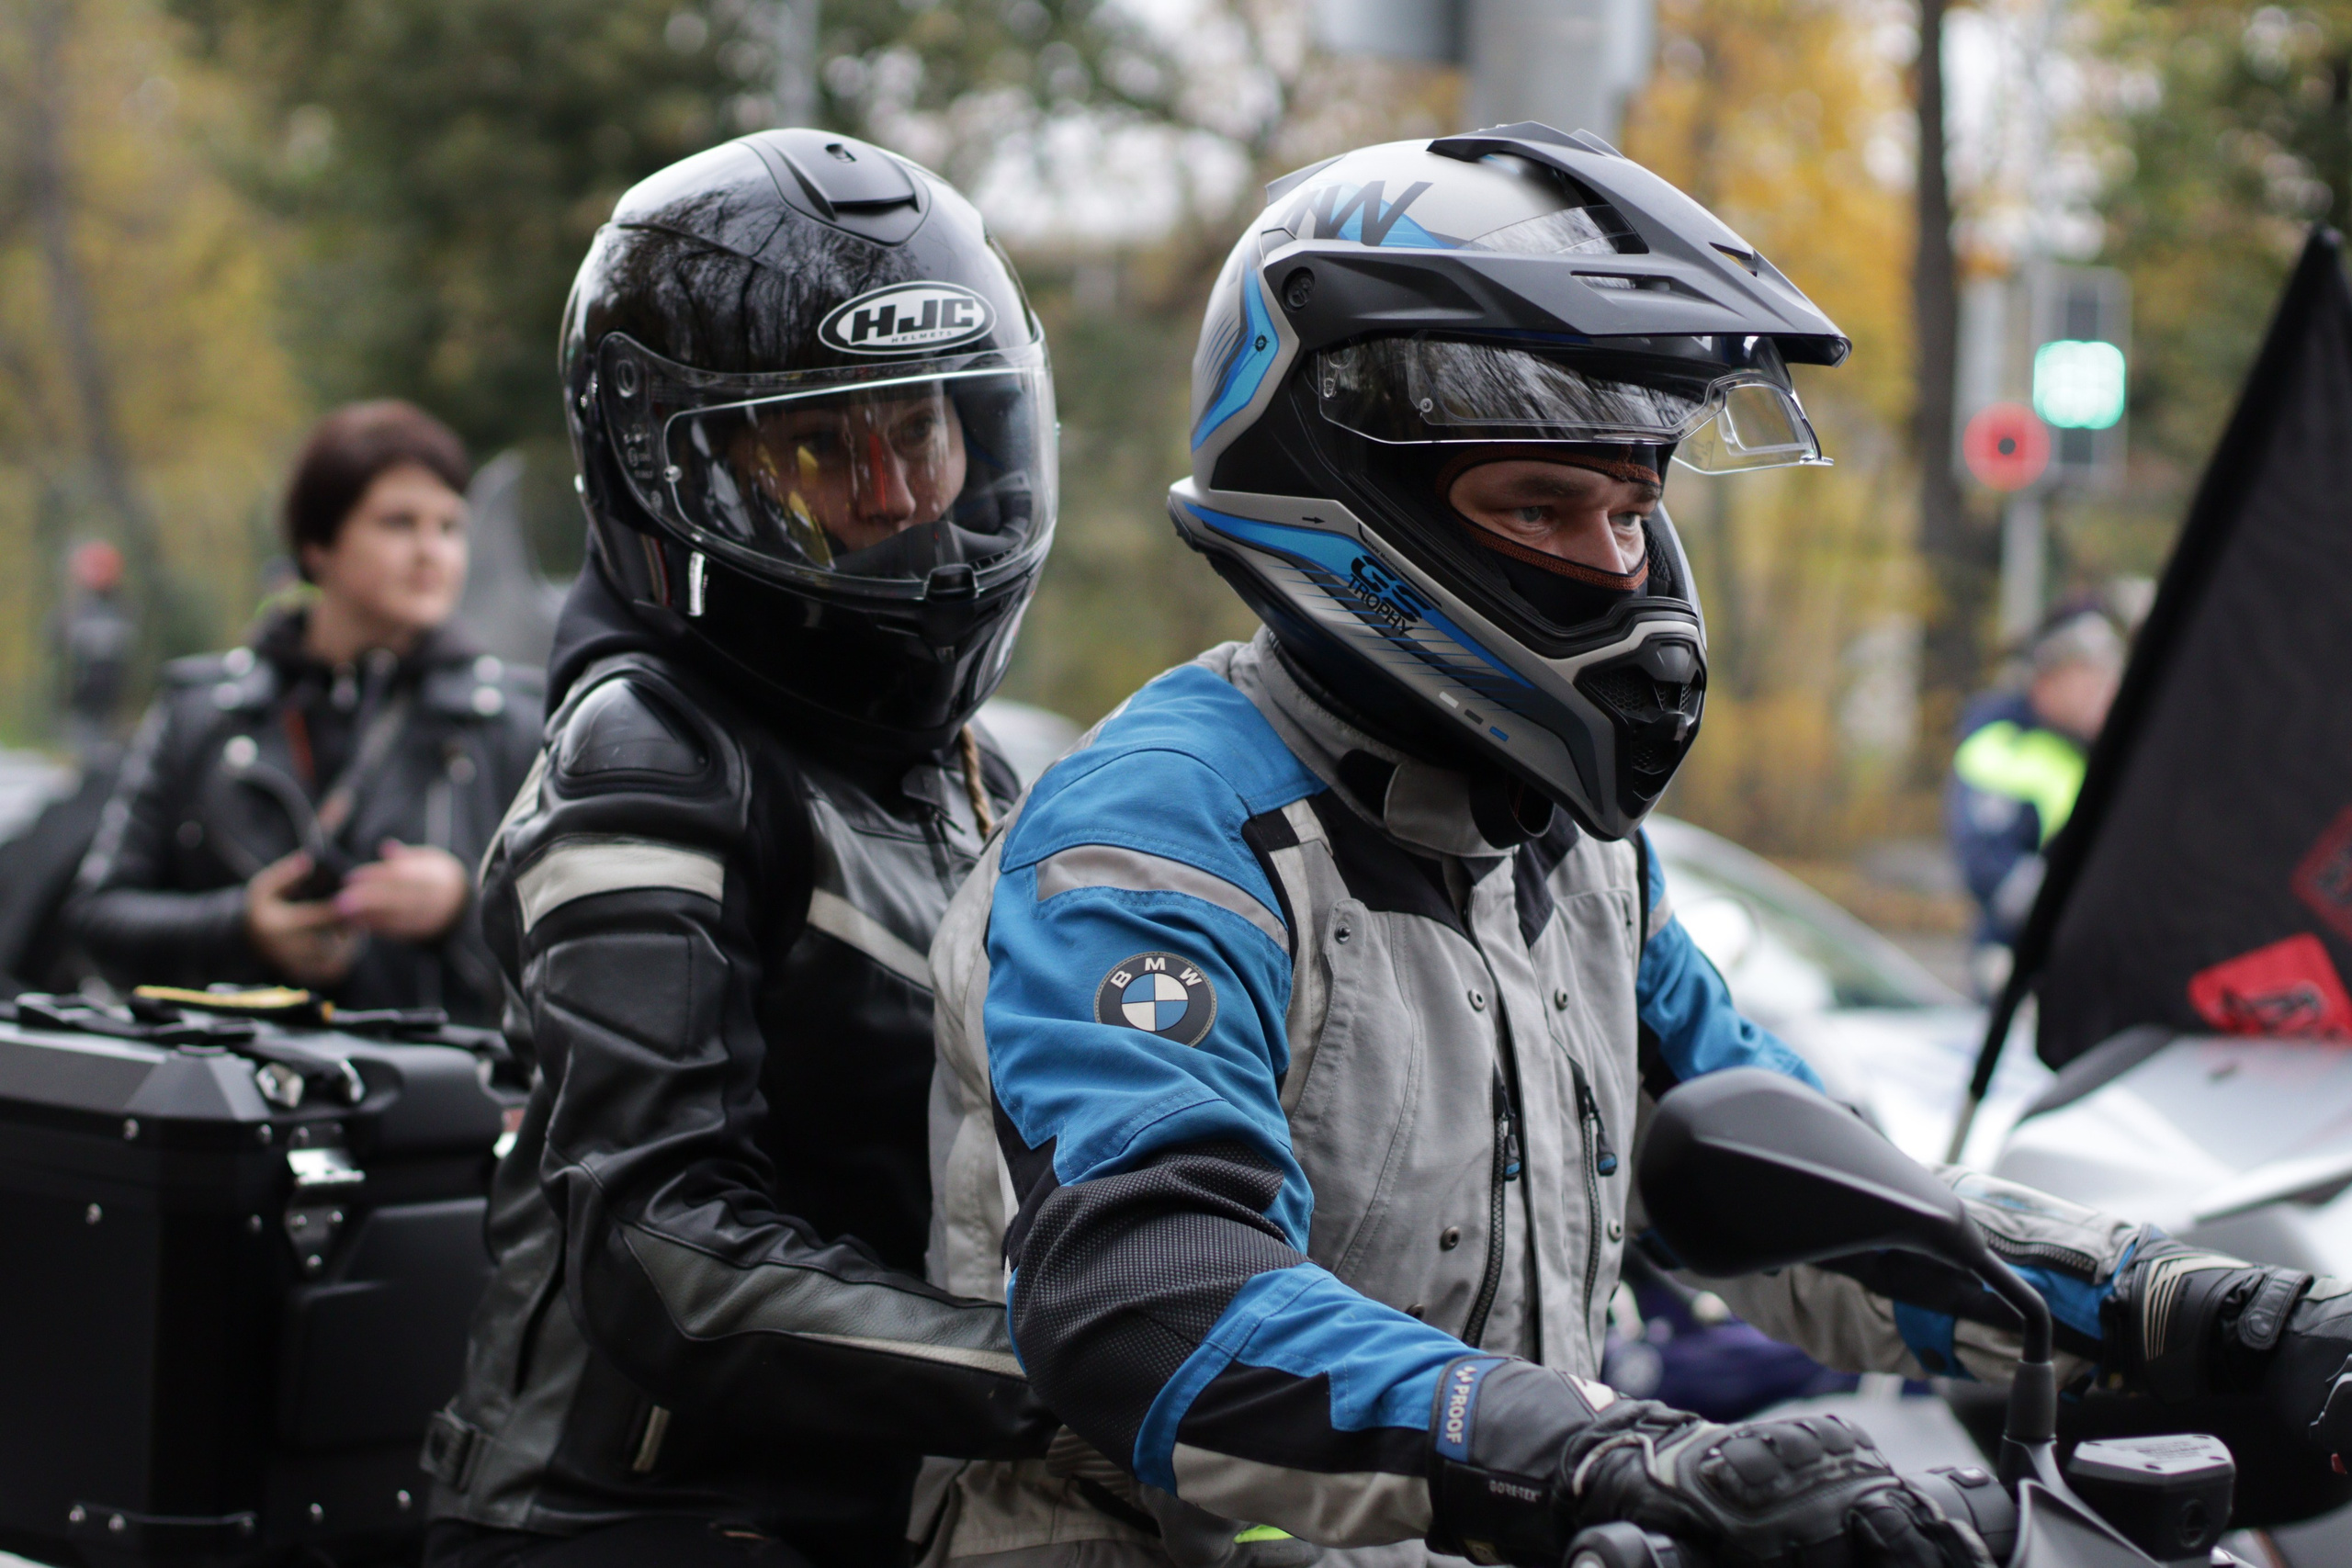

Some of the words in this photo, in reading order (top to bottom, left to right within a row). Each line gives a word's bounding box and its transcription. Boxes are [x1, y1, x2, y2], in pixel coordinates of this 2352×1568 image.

[851, 299, 975, 343] HJC
[891, 330, 953, 344] HELMETS
[1347, 572, 1415, 636] TROPHY
[1351, 555, 1432, 623] GS
[1110, 957, 1203, 989] BMW
[1445, 1384, 1471, 1444] PROOF
